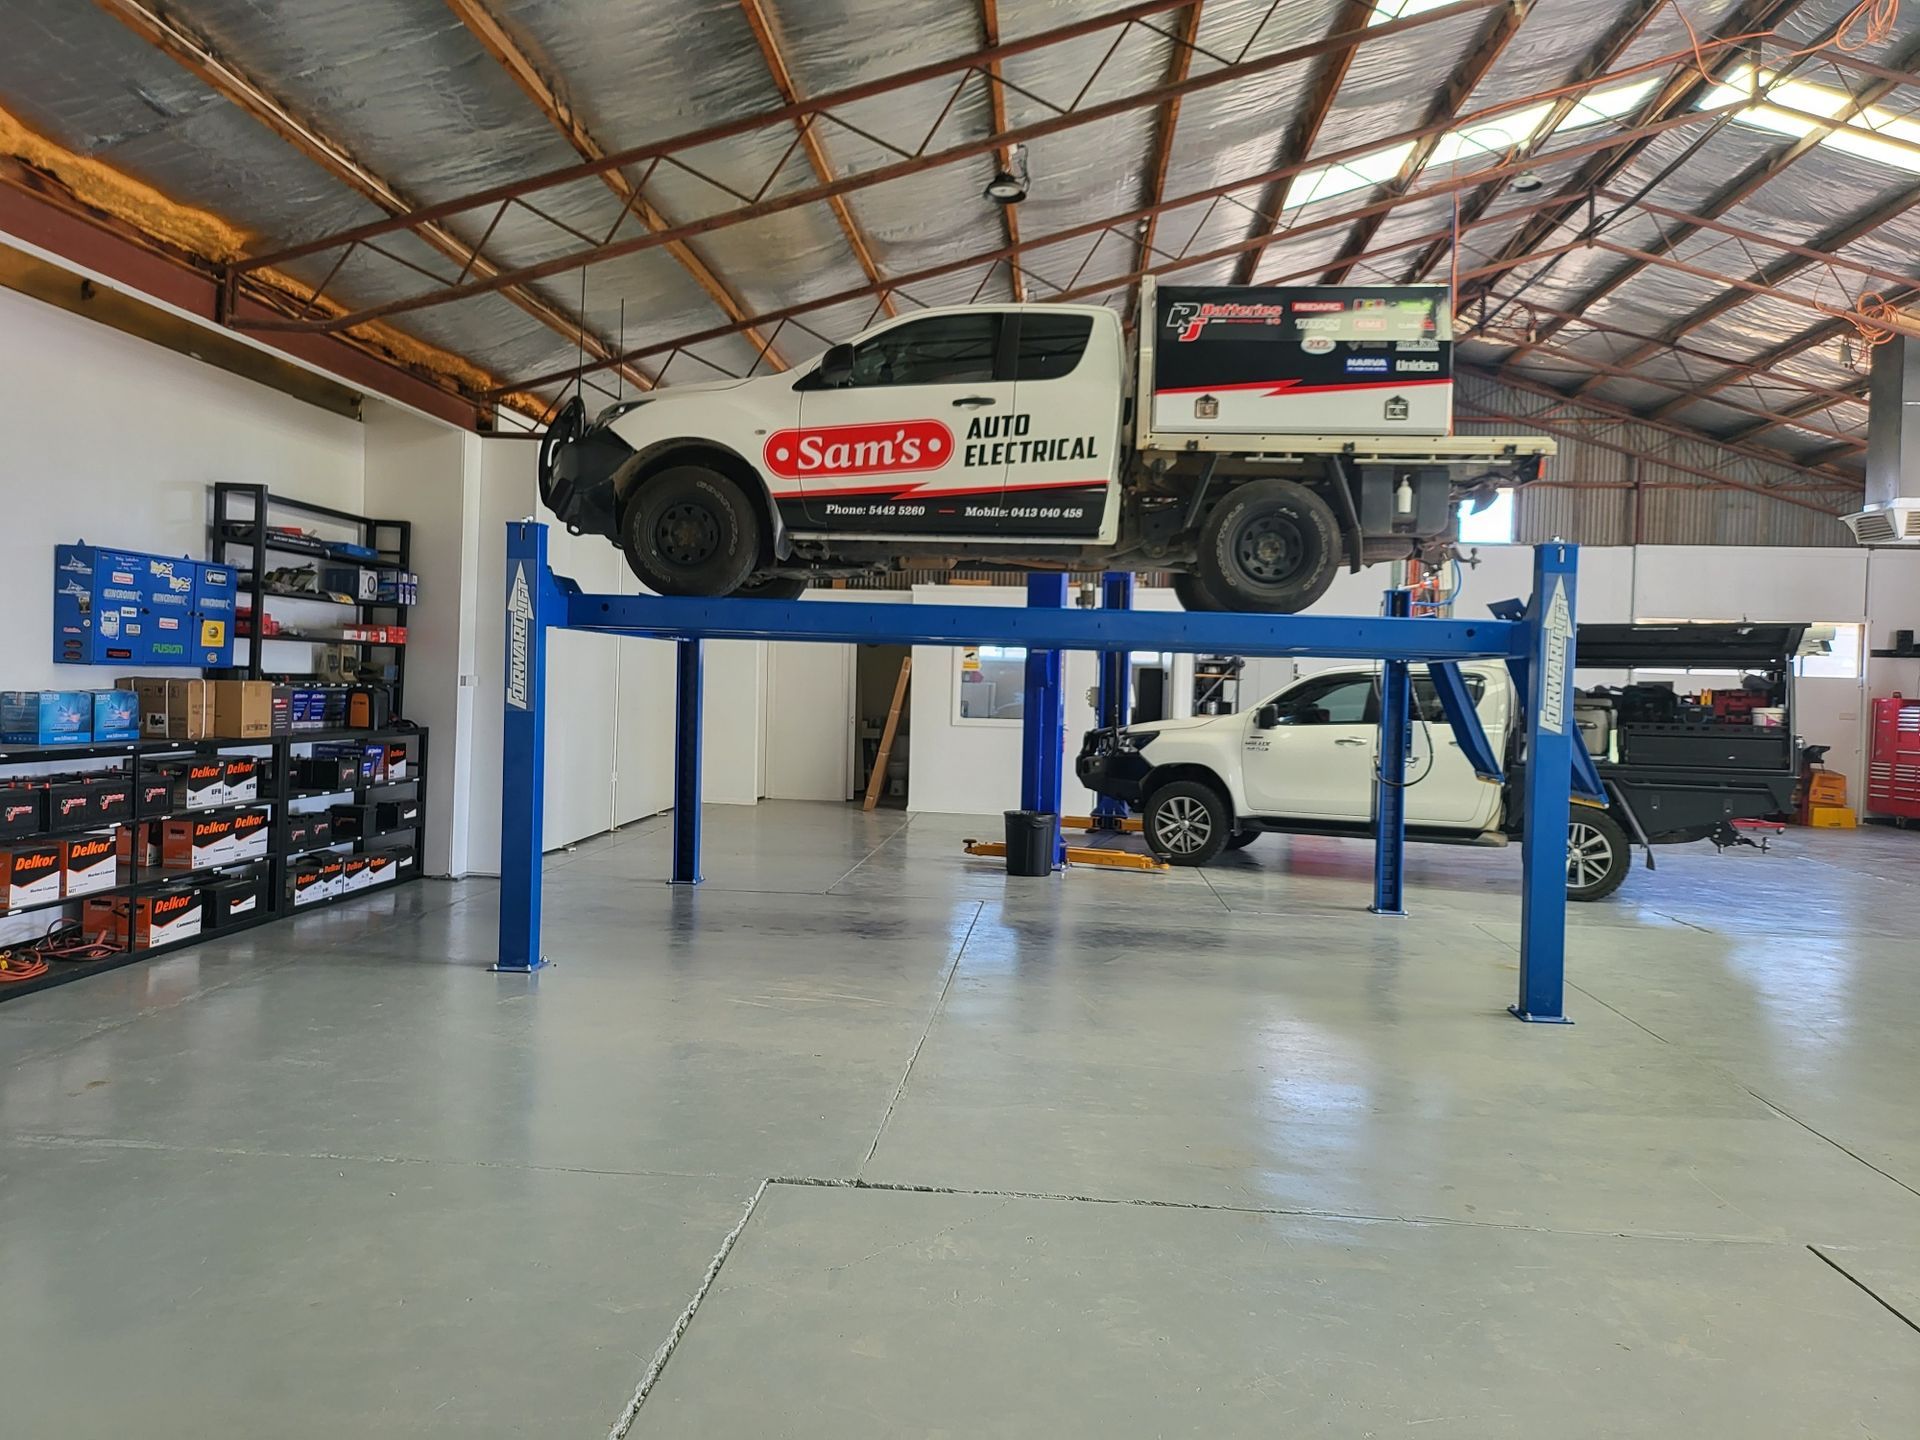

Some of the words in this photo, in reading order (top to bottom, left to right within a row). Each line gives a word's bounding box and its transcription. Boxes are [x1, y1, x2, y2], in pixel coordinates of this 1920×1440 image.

[1201, 303, 1283, 318] Batteries
[1294, 302, 1343, 312] REDARC
[1347, 358, 1388, 367] NARVA
[1396, 360, 1439, 372] Uniden
[966, 414, 1030, 440] AUTO
[797, 430, 921, 470] Sam's
[964, 436, 1099, 468] ELECTRICAL
[825, 504, 867, 515] Phone:
[869, 505, 896, 516] 5442
[898, 506, 926, 516] 5260
[964, 506, 1009, 518] Mobile:
[1011, 507, 1038, 518] 0413
[1040, 508, 1061, 518] 040
[1062, 508, 1084, 519] 458
[152, 643, 183, 654] FUSION
[191, 766, 220, 779] Delkor
[226, 761, 255, 775] Delkor
[196, 821, 231, 836] Delkor
[234, 815, 264, 829] Delkor
[71, 841, 111, 858] Delkor
[15, 854, 57, 871] Delkor
[155, 895, 192, 914] Delkor
